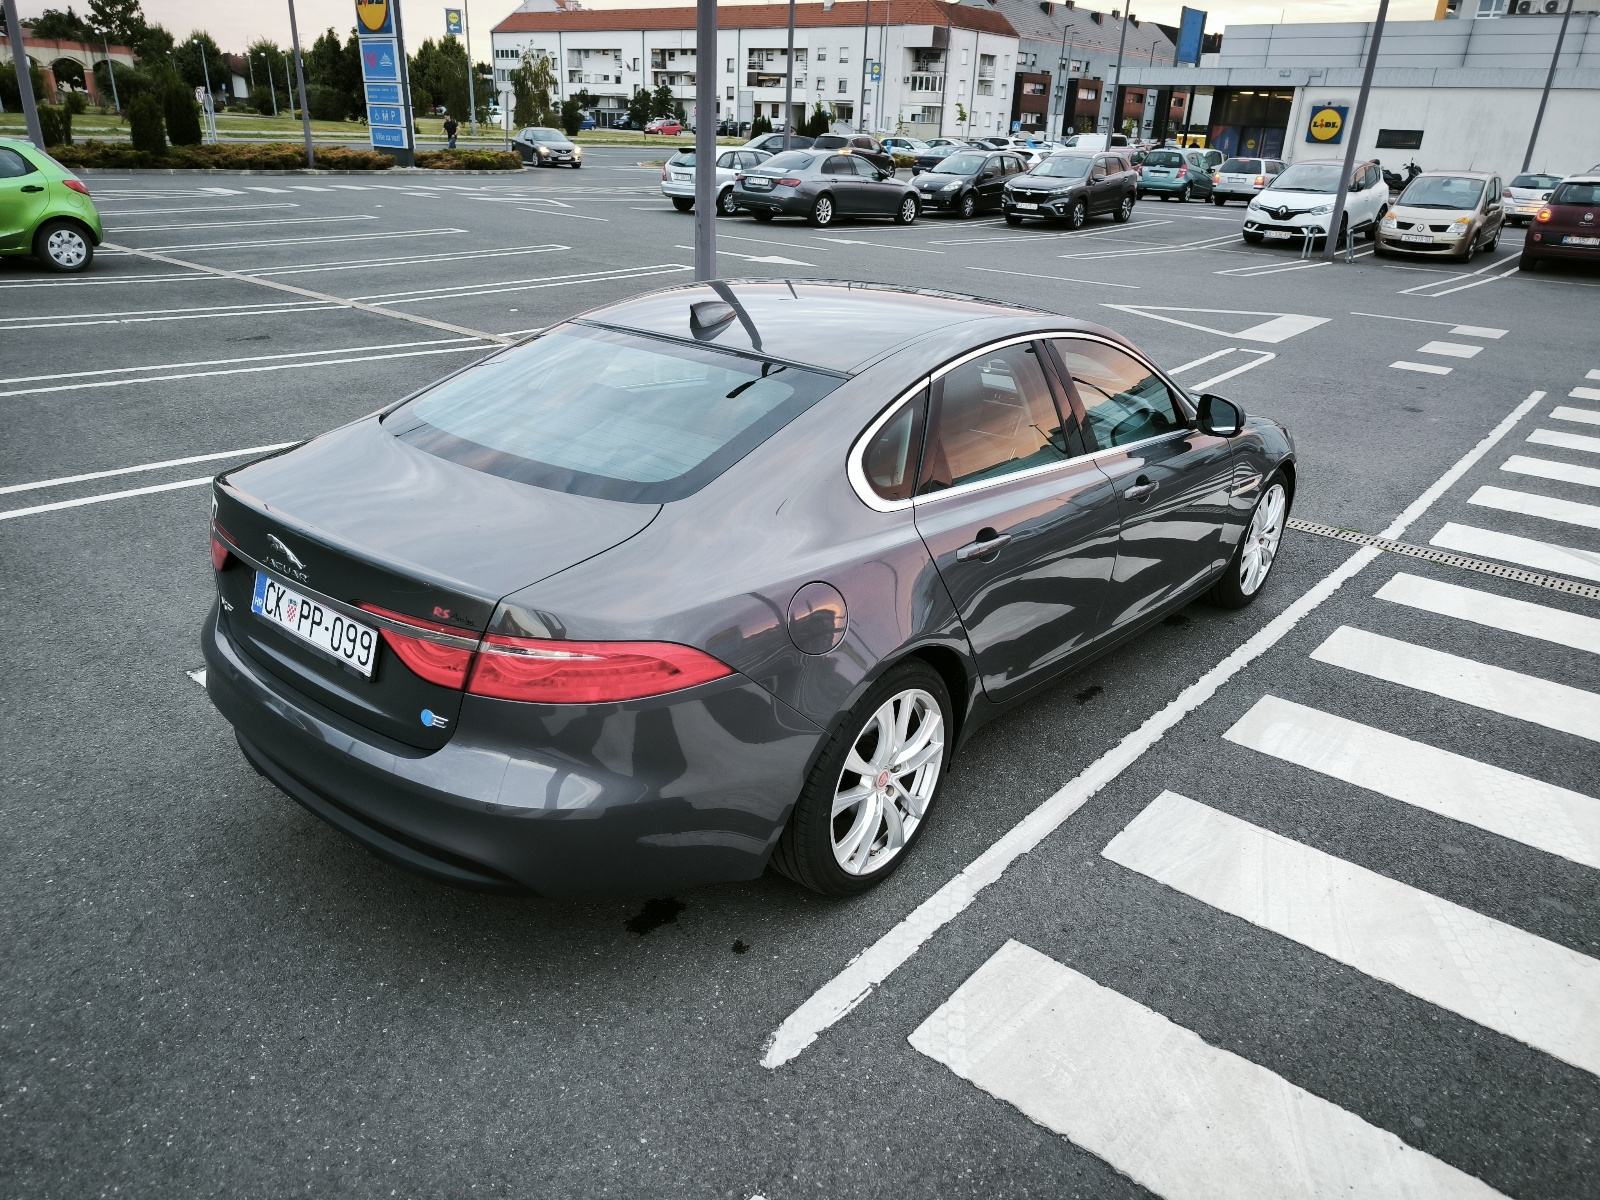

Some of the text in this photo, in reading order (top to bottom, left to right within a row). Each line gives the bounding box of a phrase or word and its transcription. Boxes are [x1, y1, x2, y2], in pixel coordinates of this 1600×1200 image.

[1313, 118, 1338, 128] LIDL
[262, 557, 309, 583] JAGUAR
[298, 599, 372, 666] PP-099
